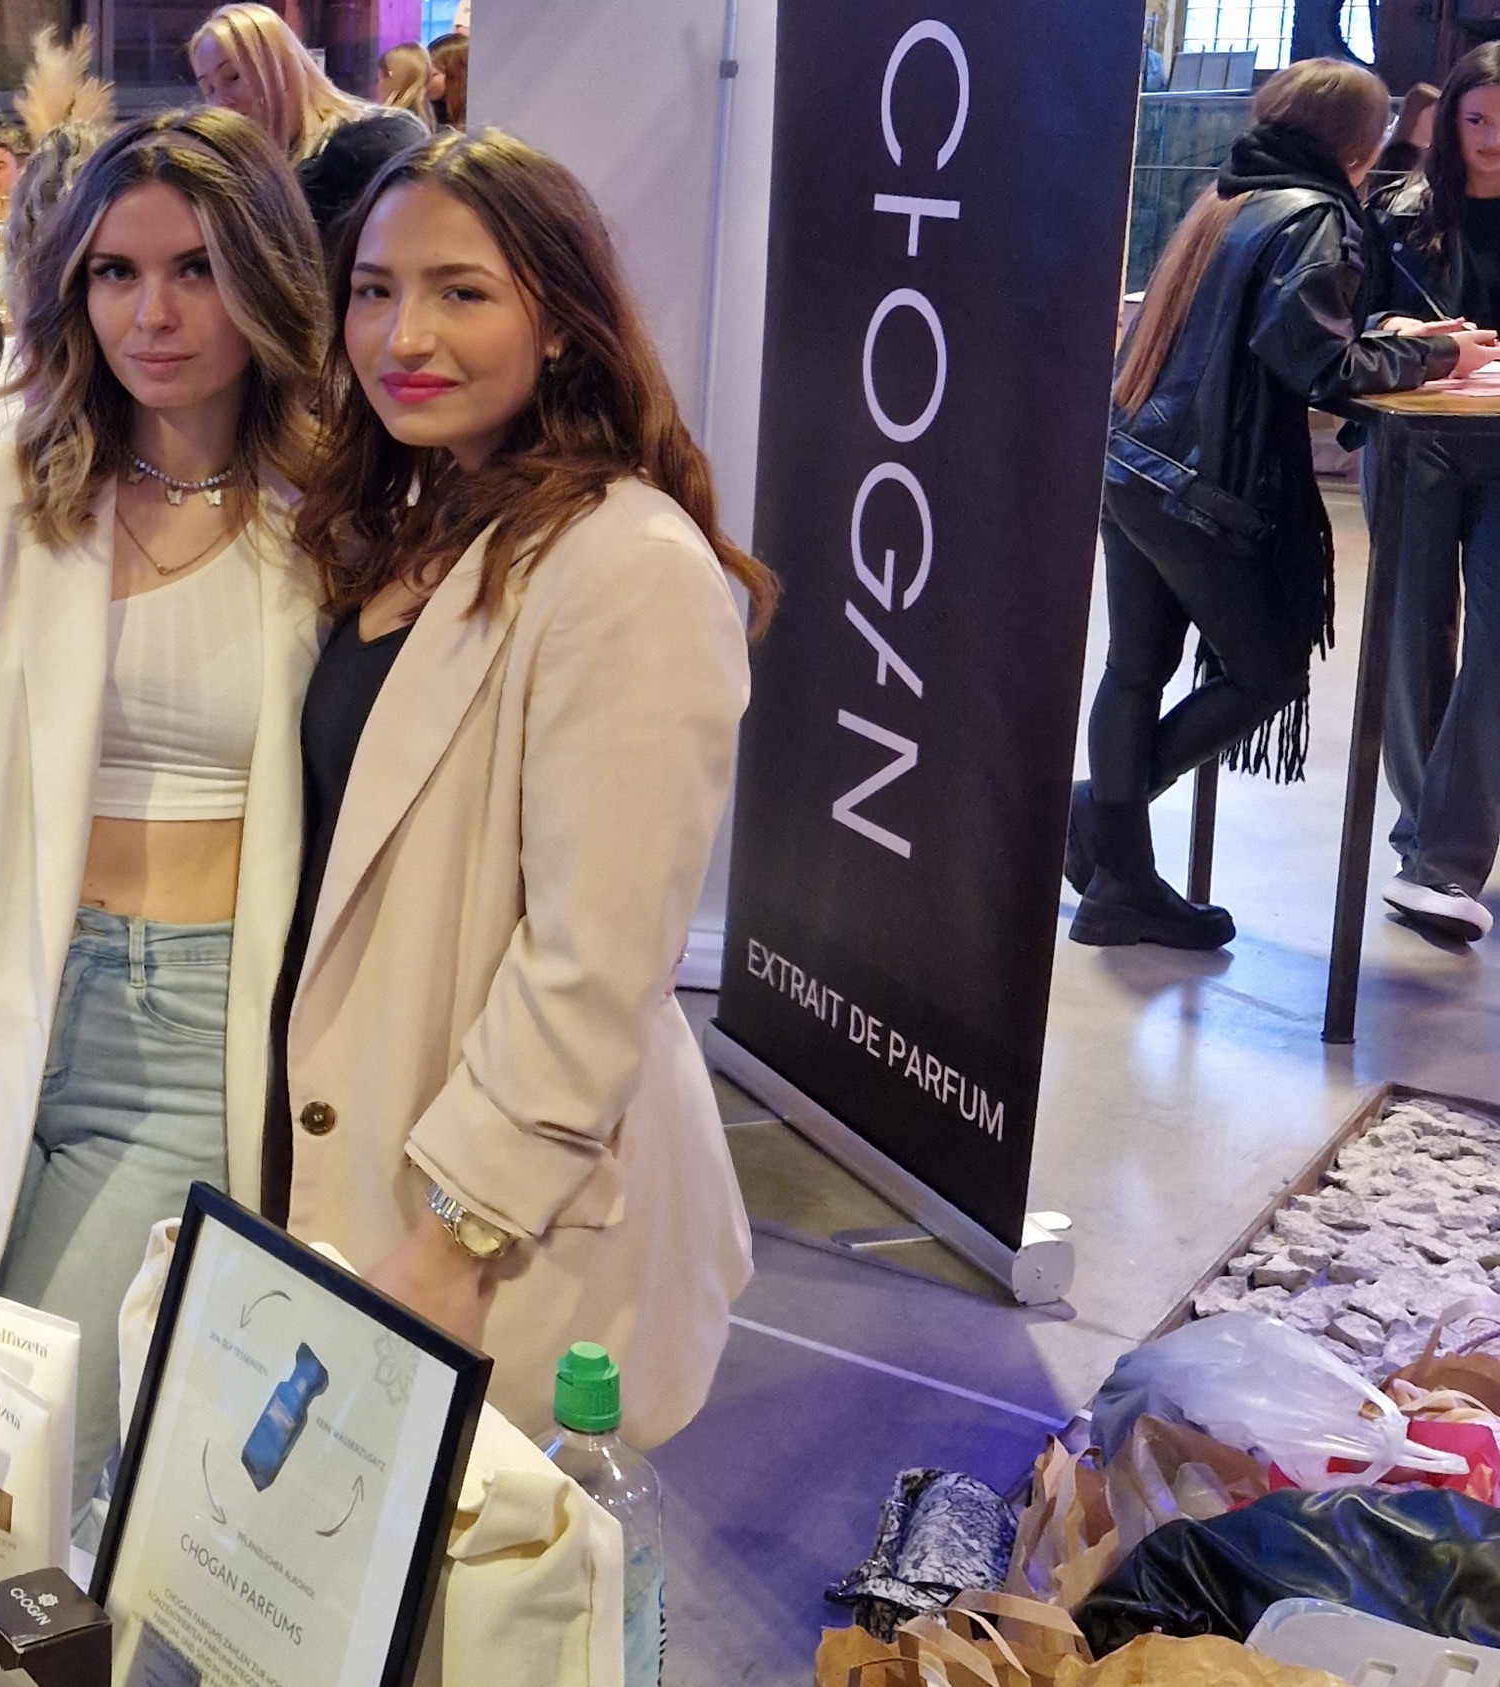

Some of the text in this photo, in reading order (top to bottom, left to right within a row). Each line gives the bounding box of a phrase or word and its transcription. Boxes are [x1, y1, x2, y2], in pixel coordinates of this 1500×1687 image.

[831, 18, 970, 860] CHOGAN
[747, 938, 1005, 1143] EXTRAIT DE PARFUM
[10, 1587, 52, 1626] CHOGAN
[180, 1533, 304, 1646] CHOGAN PARFUMS
